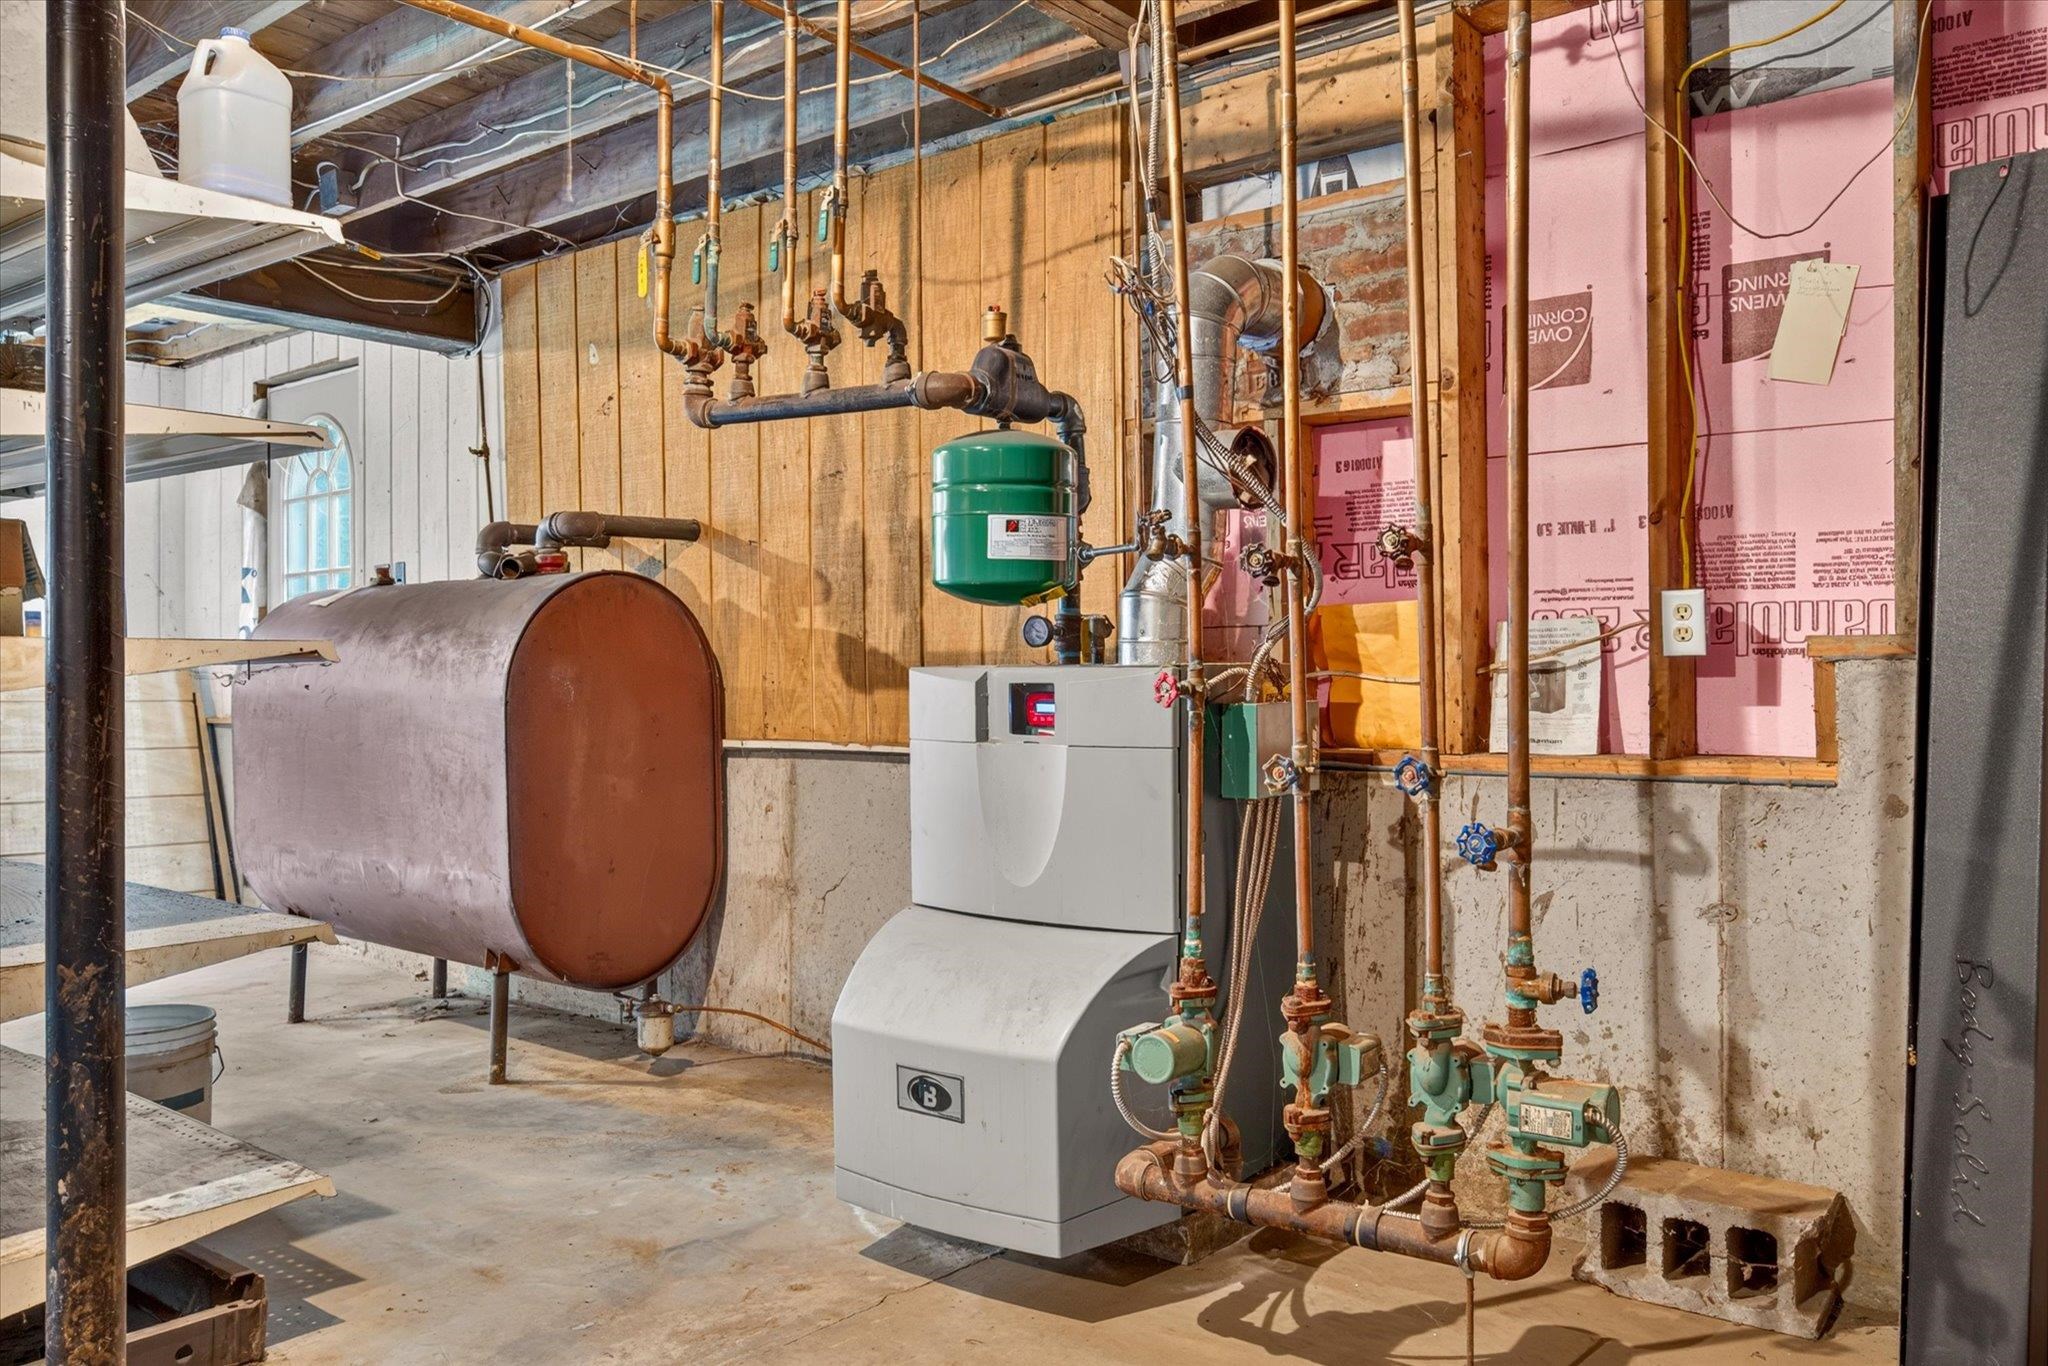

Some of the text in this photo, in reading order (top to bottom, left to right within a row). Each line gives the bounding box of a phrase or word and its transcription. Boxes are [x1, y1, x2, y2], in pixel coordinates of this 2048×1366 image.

[1728, 272, 1790, 293] RNING
[1729, 292, 1788, 313] WENS
[1528, 307, 1588, 328] CORNI
[1528, 326, 1573, 342] OWE
[1243, 515, 1268, 528] ENS
